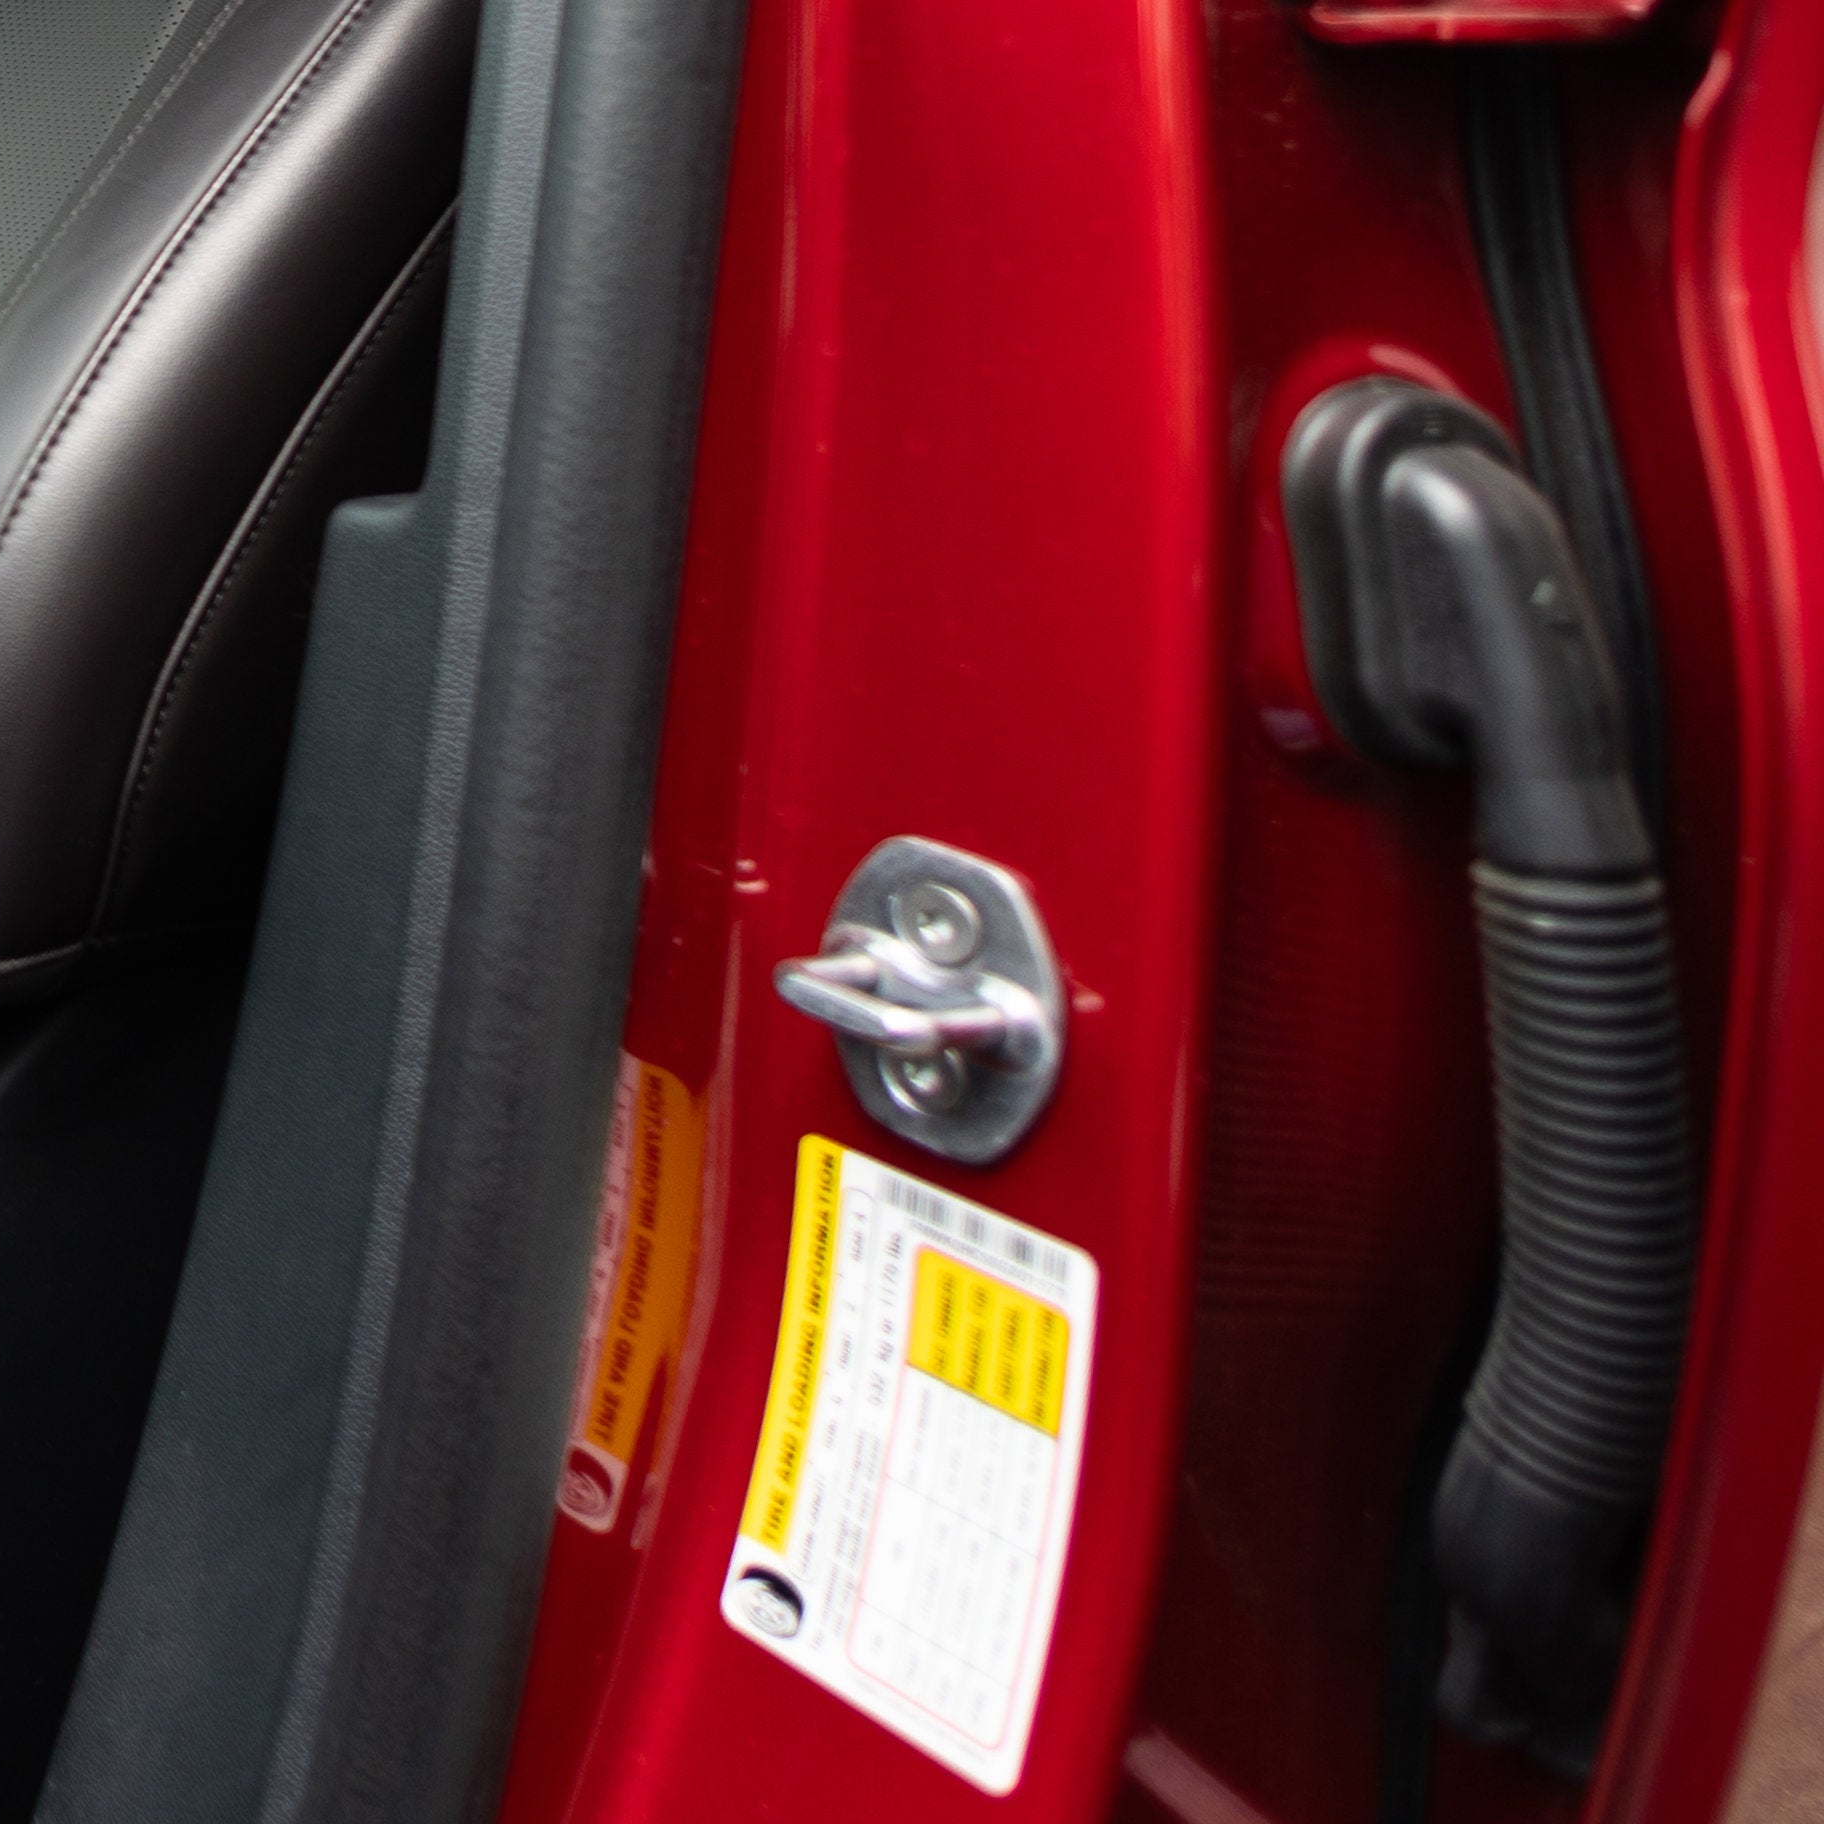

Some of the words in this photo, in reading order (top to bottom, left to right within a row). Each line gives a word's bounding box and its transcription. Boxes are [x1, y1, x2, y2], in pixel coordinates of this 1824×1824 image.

[806, 1152, 836, 1316] INFORMATION
[787, 1320, 819, 1428] LOADING
[778, 1432, 798, 1484] AND
[764, 1492, 786, 1544] TIRE
